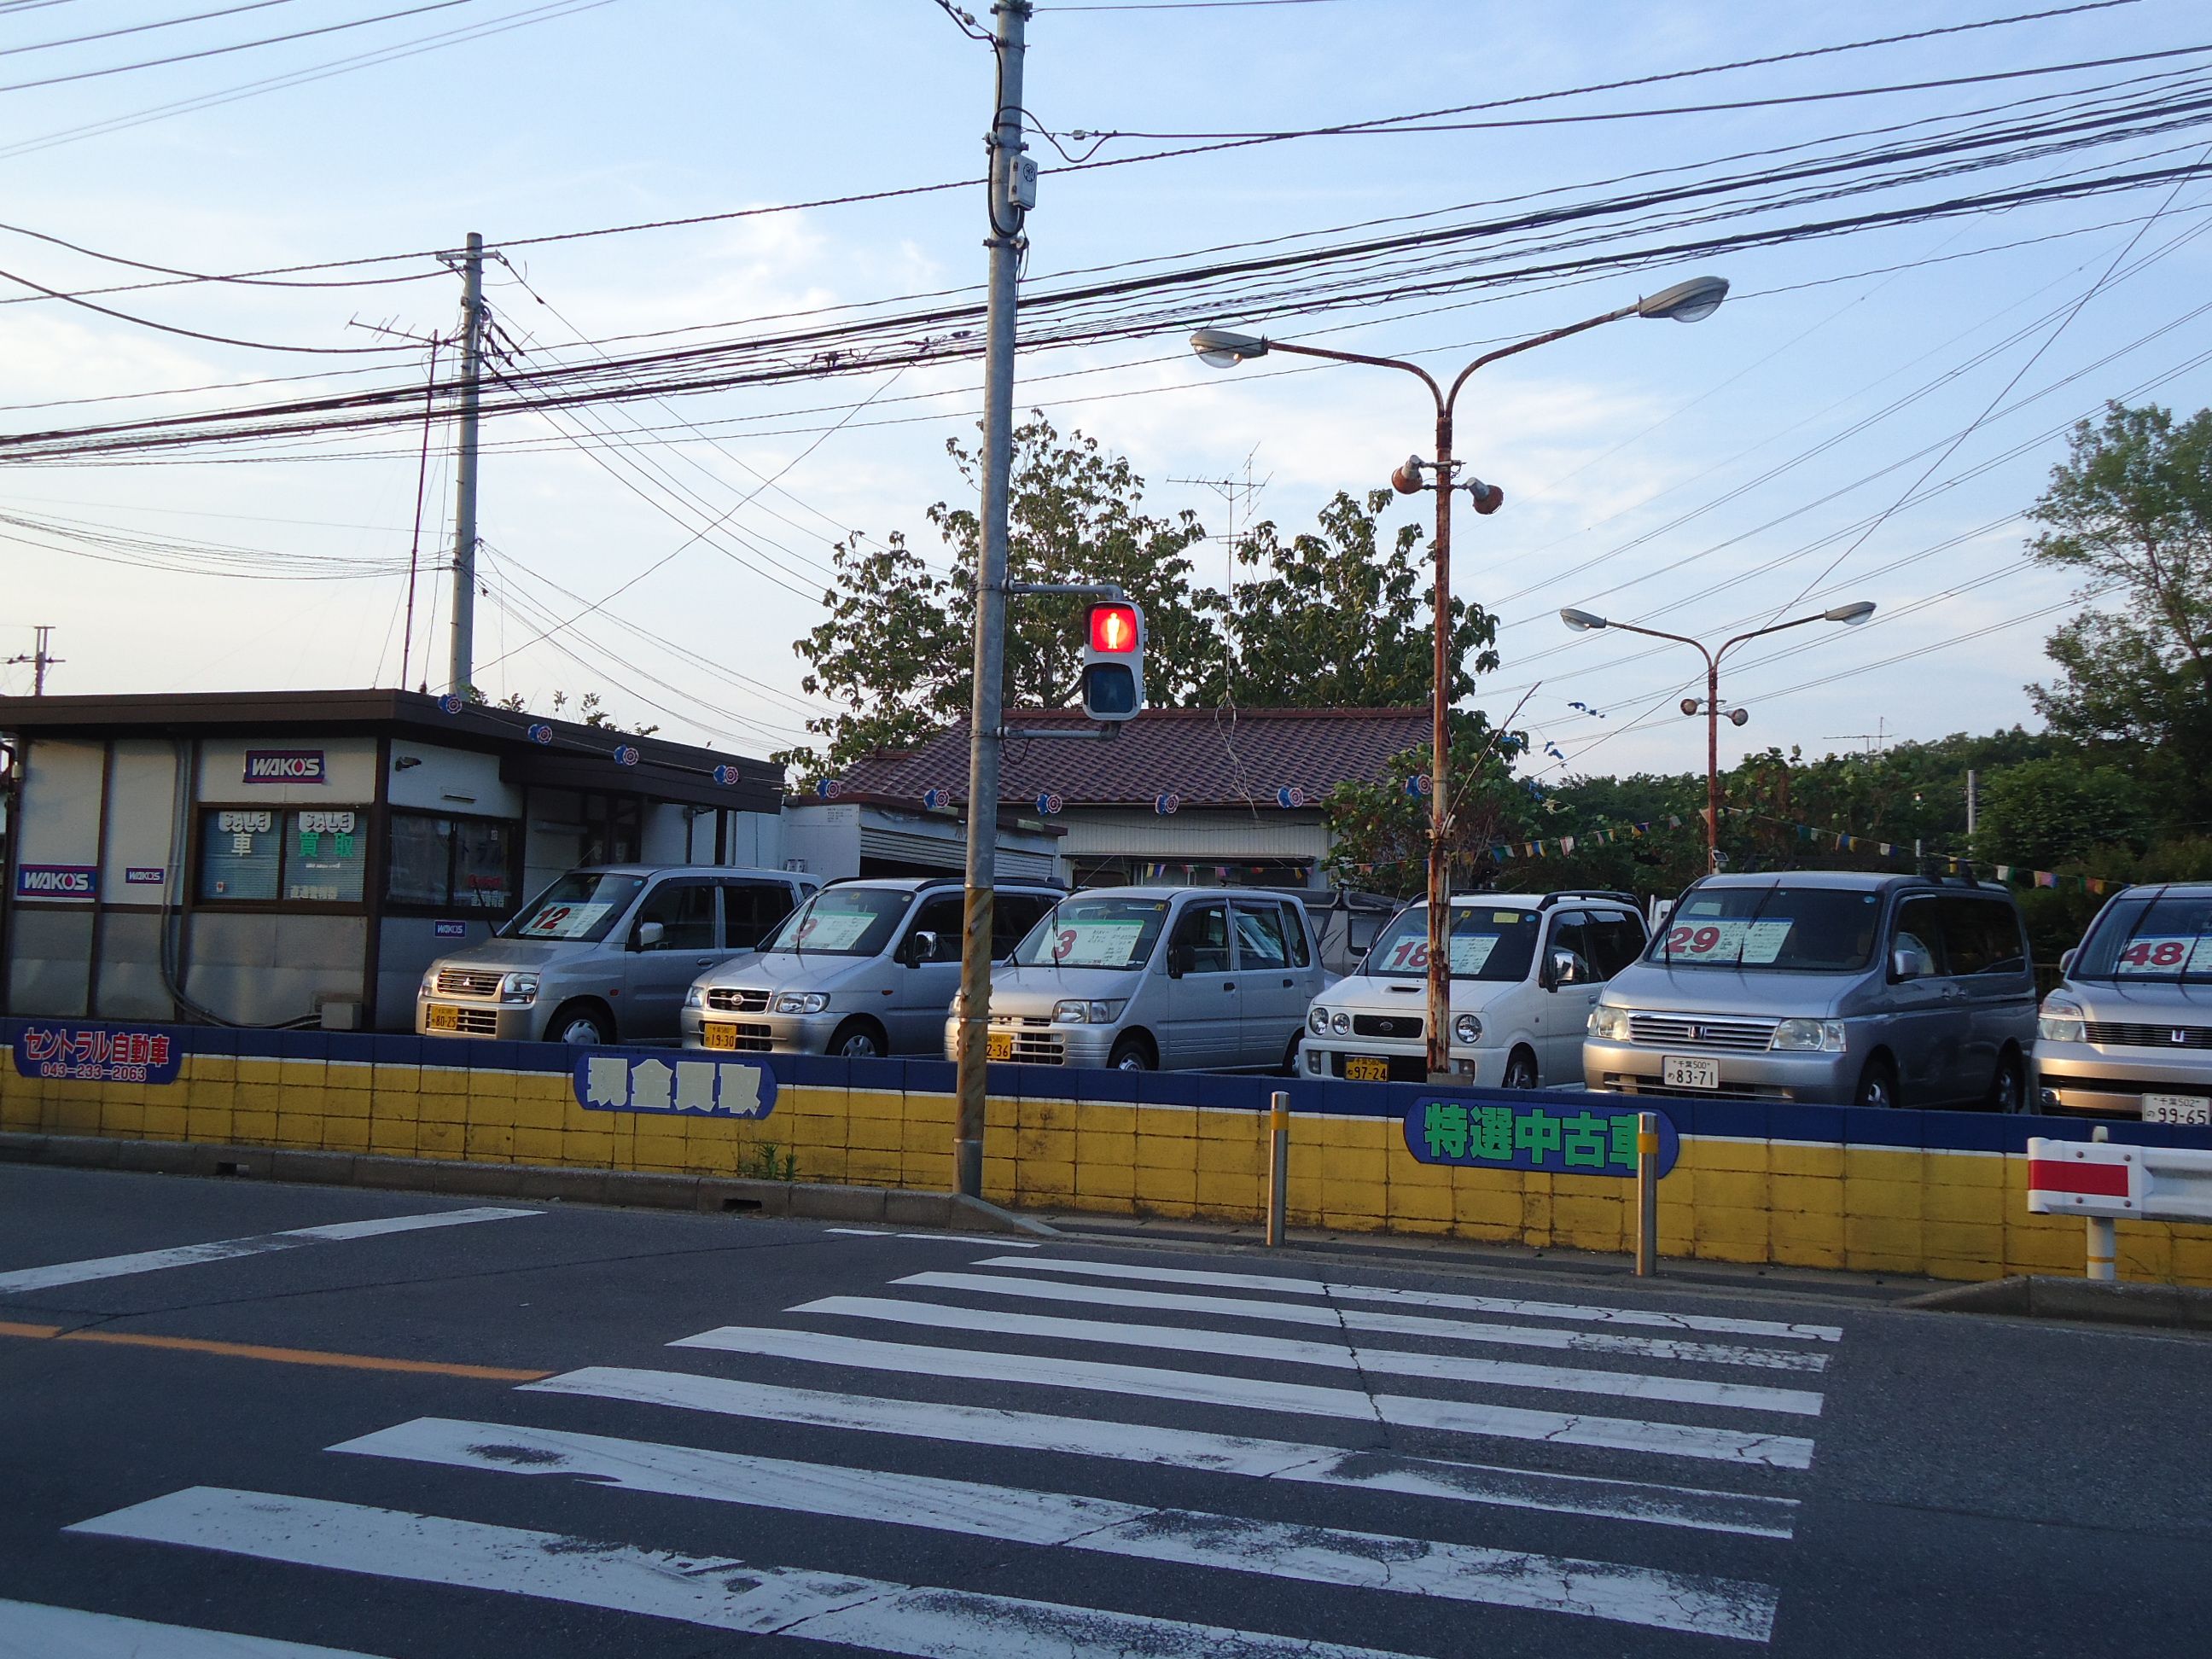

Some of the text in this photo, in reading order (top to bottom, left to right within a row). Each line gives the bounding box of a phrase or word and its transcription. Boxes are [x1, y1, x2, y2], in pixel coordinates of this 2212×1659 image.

[221, 812, 270, 830] SALE
[302, 812, 352, 831] SALE
[231, 831, 253, 857] 車
[531, 906, 571, 930] 12
[790, 918, 818, 942] 9
[1661, 926, 1720, 953] 29
[1051, 929, 1078, 959] 3
[1393, 941, 1429, 967] 18
[2120, 942, 2185, 966] 48
[435, 1016, 457, 1027] 80-25
[24, 1027, 170, 1067] セントラル自動車
[711, 1033, 734, 1047] 19-30
[41, 1062, 147, 1082] 043-233-2063
[1354, 1066, 1386, 1080] 97-24
[1676, 1069, 1714, 1086] 83-71
[2157, 1107, 2207, 1124] 99-65
